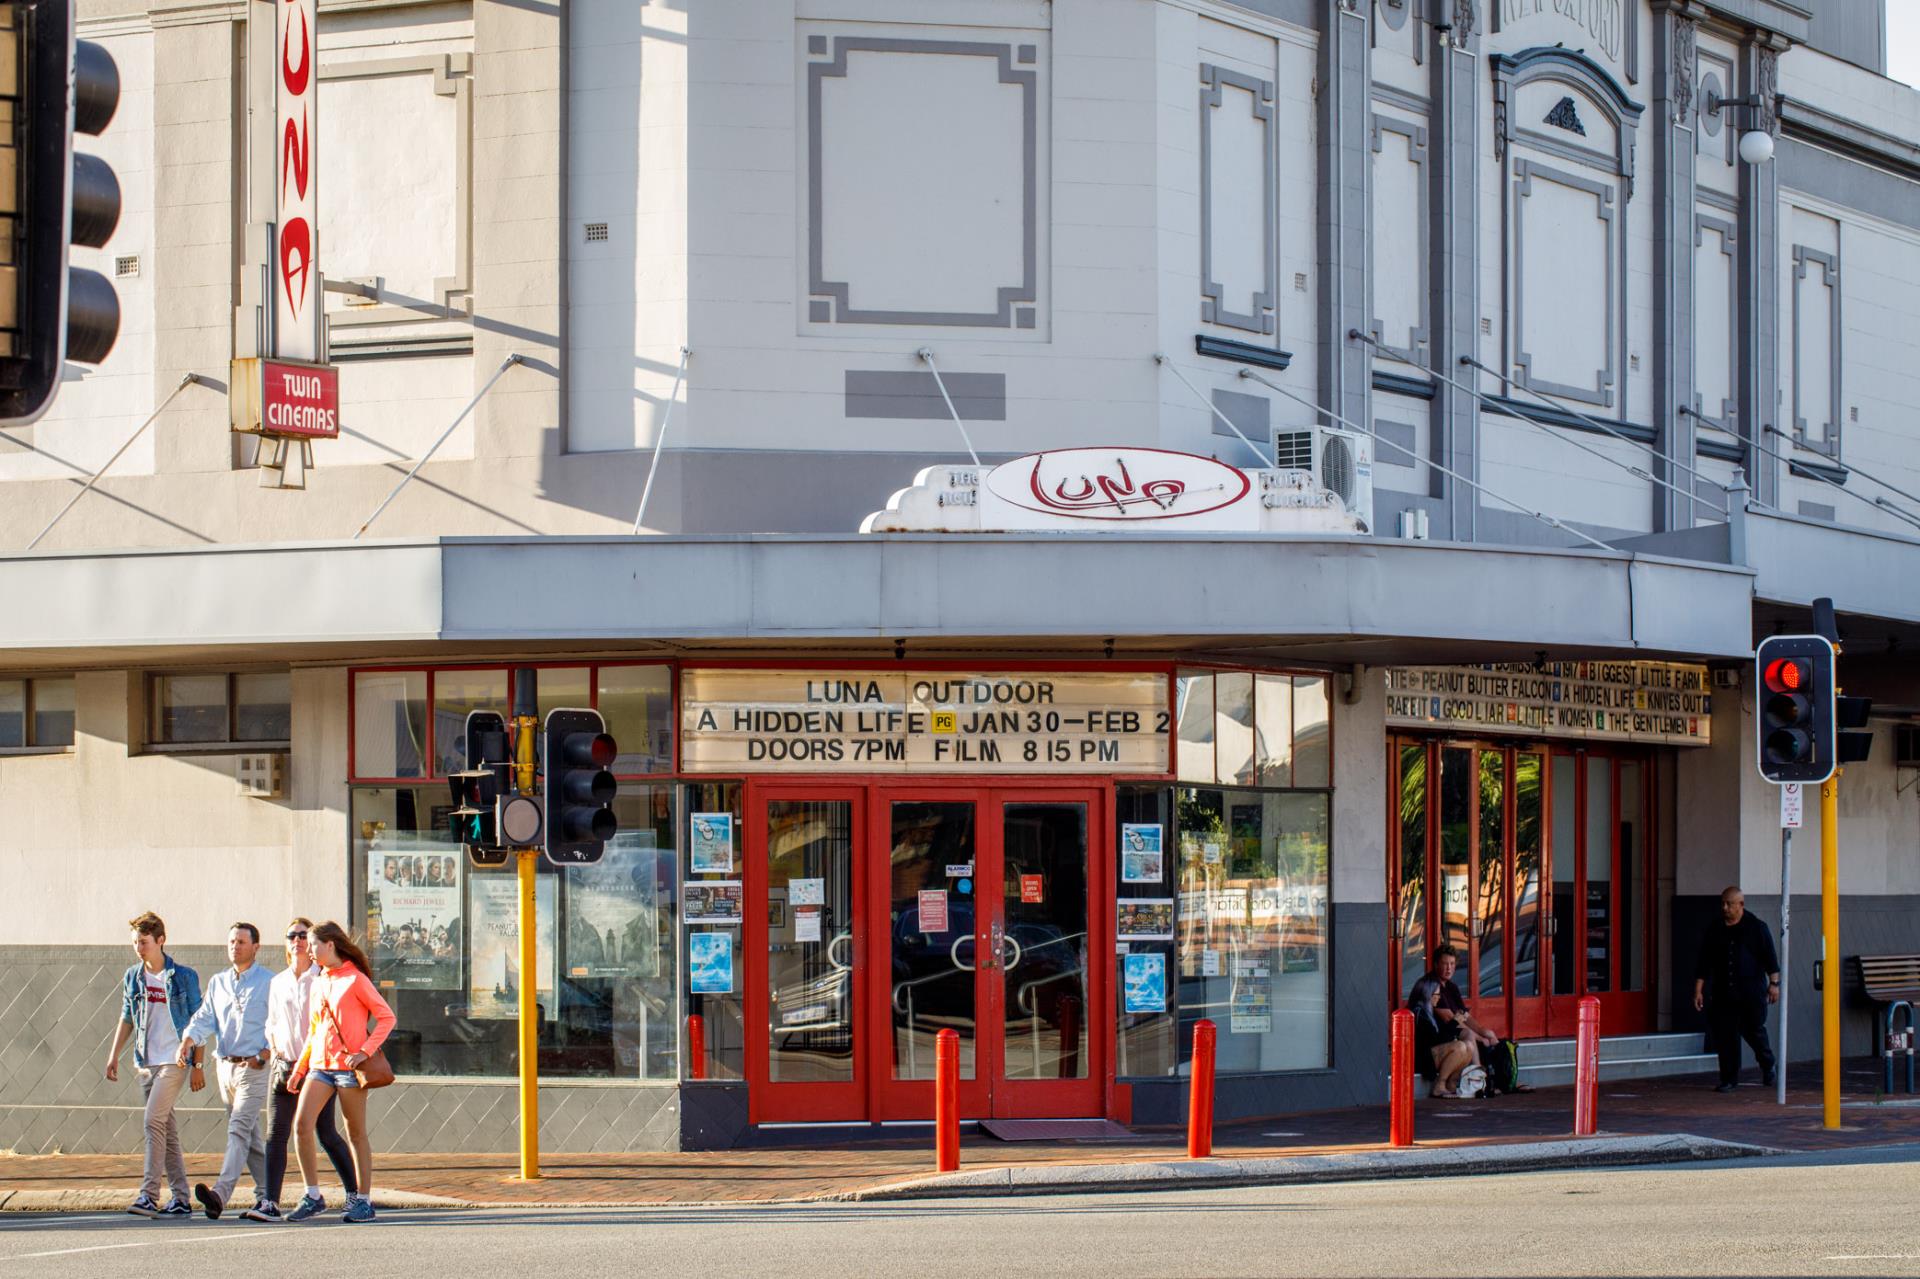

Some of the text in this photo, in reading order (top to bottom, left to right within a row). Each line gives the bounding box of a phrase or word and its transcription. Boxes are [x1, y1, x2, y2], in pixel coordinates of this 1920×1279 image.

[280, 0, 313, 324] UNA
[283, 373, 321, 400] TWIN
[268, 403, 335, 431] CINEMAS
[1589, 663, 1637, 684] BIGGEST
[1641, 666, 1671, 688] LITTLE
[1675, 670, 1700, 689] FARM
[807, 680, 1054, 704] LUNA OUTDOOR
[1422, 671, 1465, 694] PEANUT
[1468, 674, 1508, 697] BUTTER
[1512, 678, 1550, 700] FALCON
[1564, 685, 1573, 702] A
[1574, 685, 1610, 707] HIDDEN
[1614, 687, 1634, 708] LIFE
[1648, 690, 1680, 712] KNIVES
[1682, 694, 1702, 713] OUT
[697, 708, 718, 731] A
[734, 709, 844, 733] HIDDEN
[858, 710, 925, 734] LIFE
[936, 716, 952, 728] PG
[963, 711, 1020, 734] JAN
[1155, 711, 1170, 733] 2
[1517, 703, 1554, 726] LITTLE
[1559, 707, 1593, 728] WOMEN
[1608, 713, 1629, 732] THE
[1633, 713, 1688, 735] GENTLEMEN
[748, 738, 844, 761] DOORS
[851, 739, 906, 761] 7PM
[934, 739, 1002, 762] FILM
[1080, 739, 1119, 762] PM
